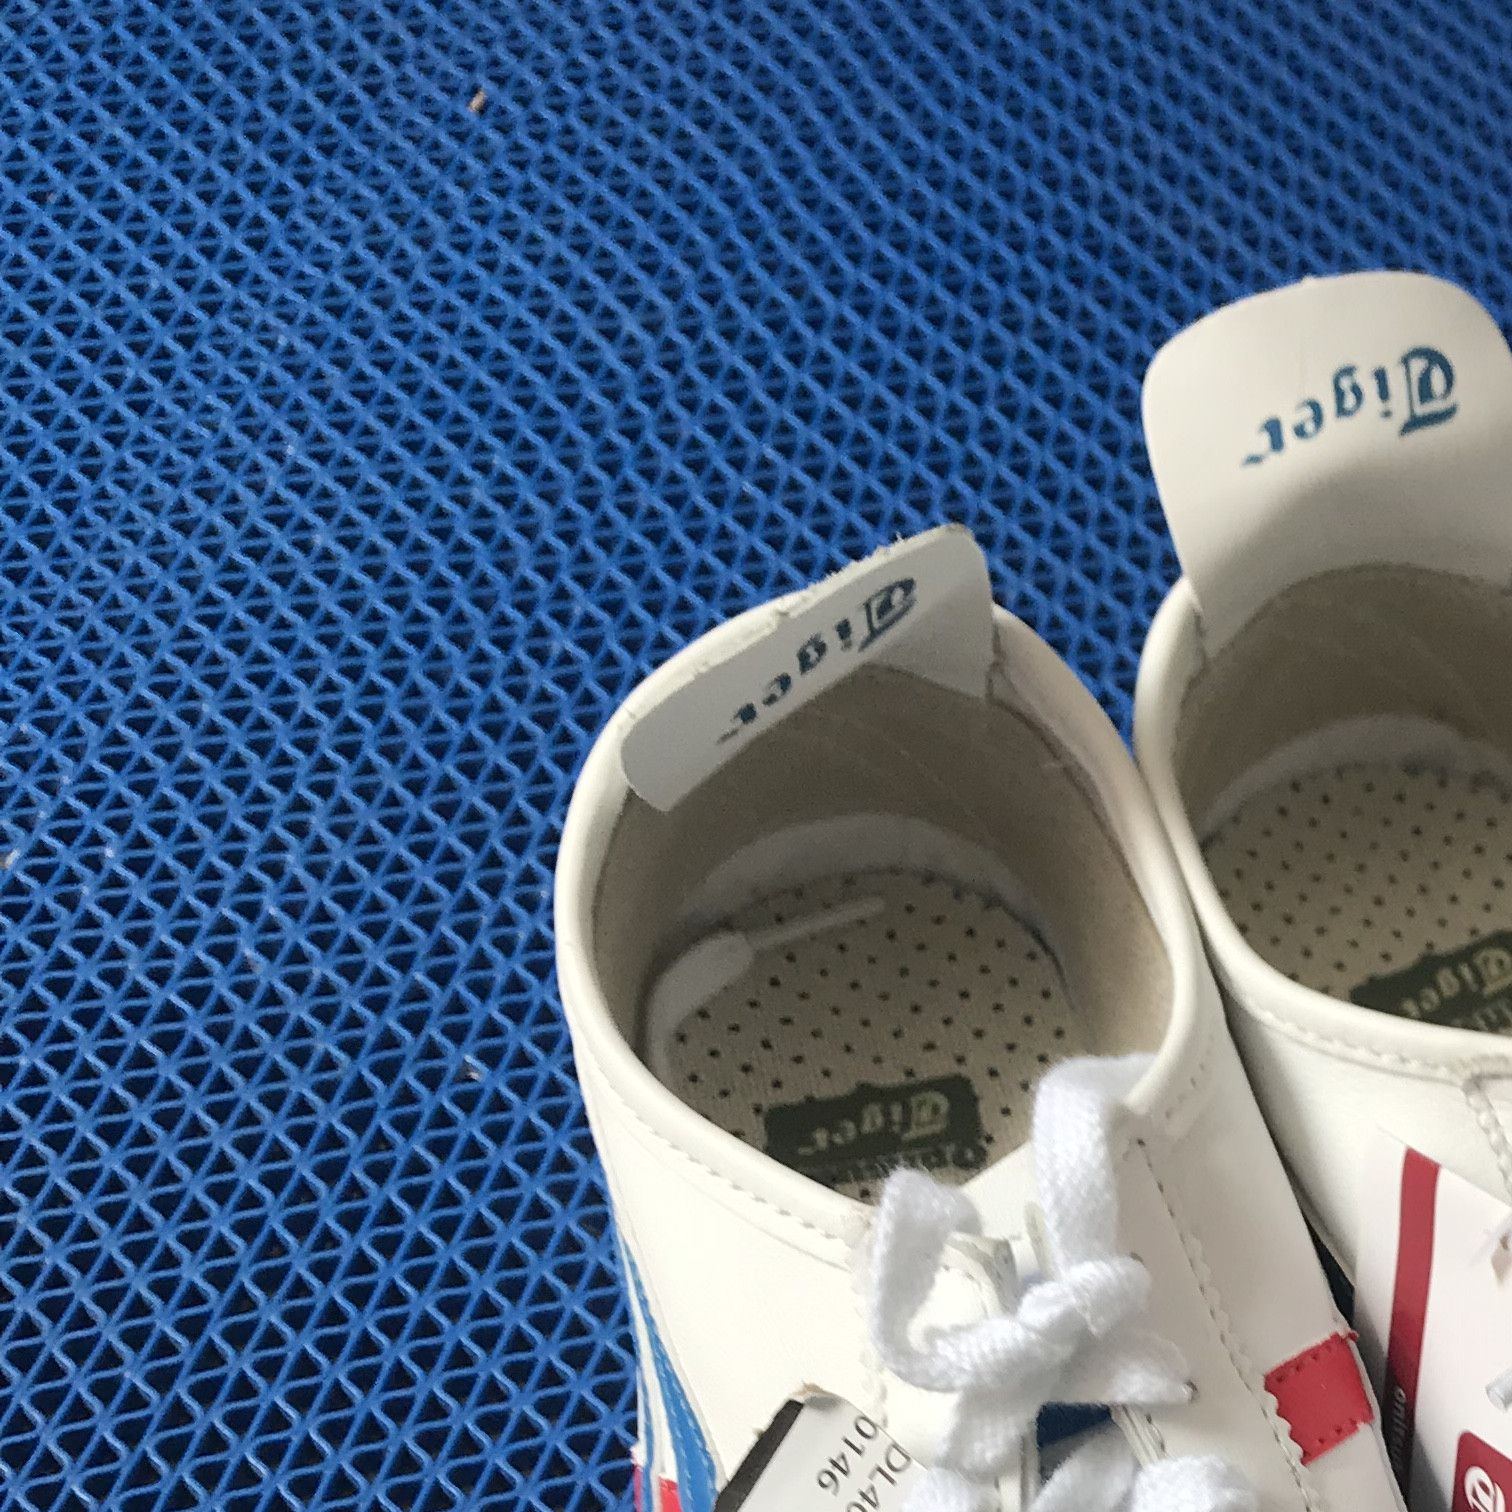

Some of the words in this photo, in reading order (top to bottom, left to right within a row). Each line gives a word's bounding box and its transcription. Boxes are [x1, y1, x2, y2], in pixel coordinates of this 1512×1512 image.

[1240, 345, 1459, 466] Tiger
[716, 577, 918, 745] Tiger
[816, 1415, 878, 1497] 0146
